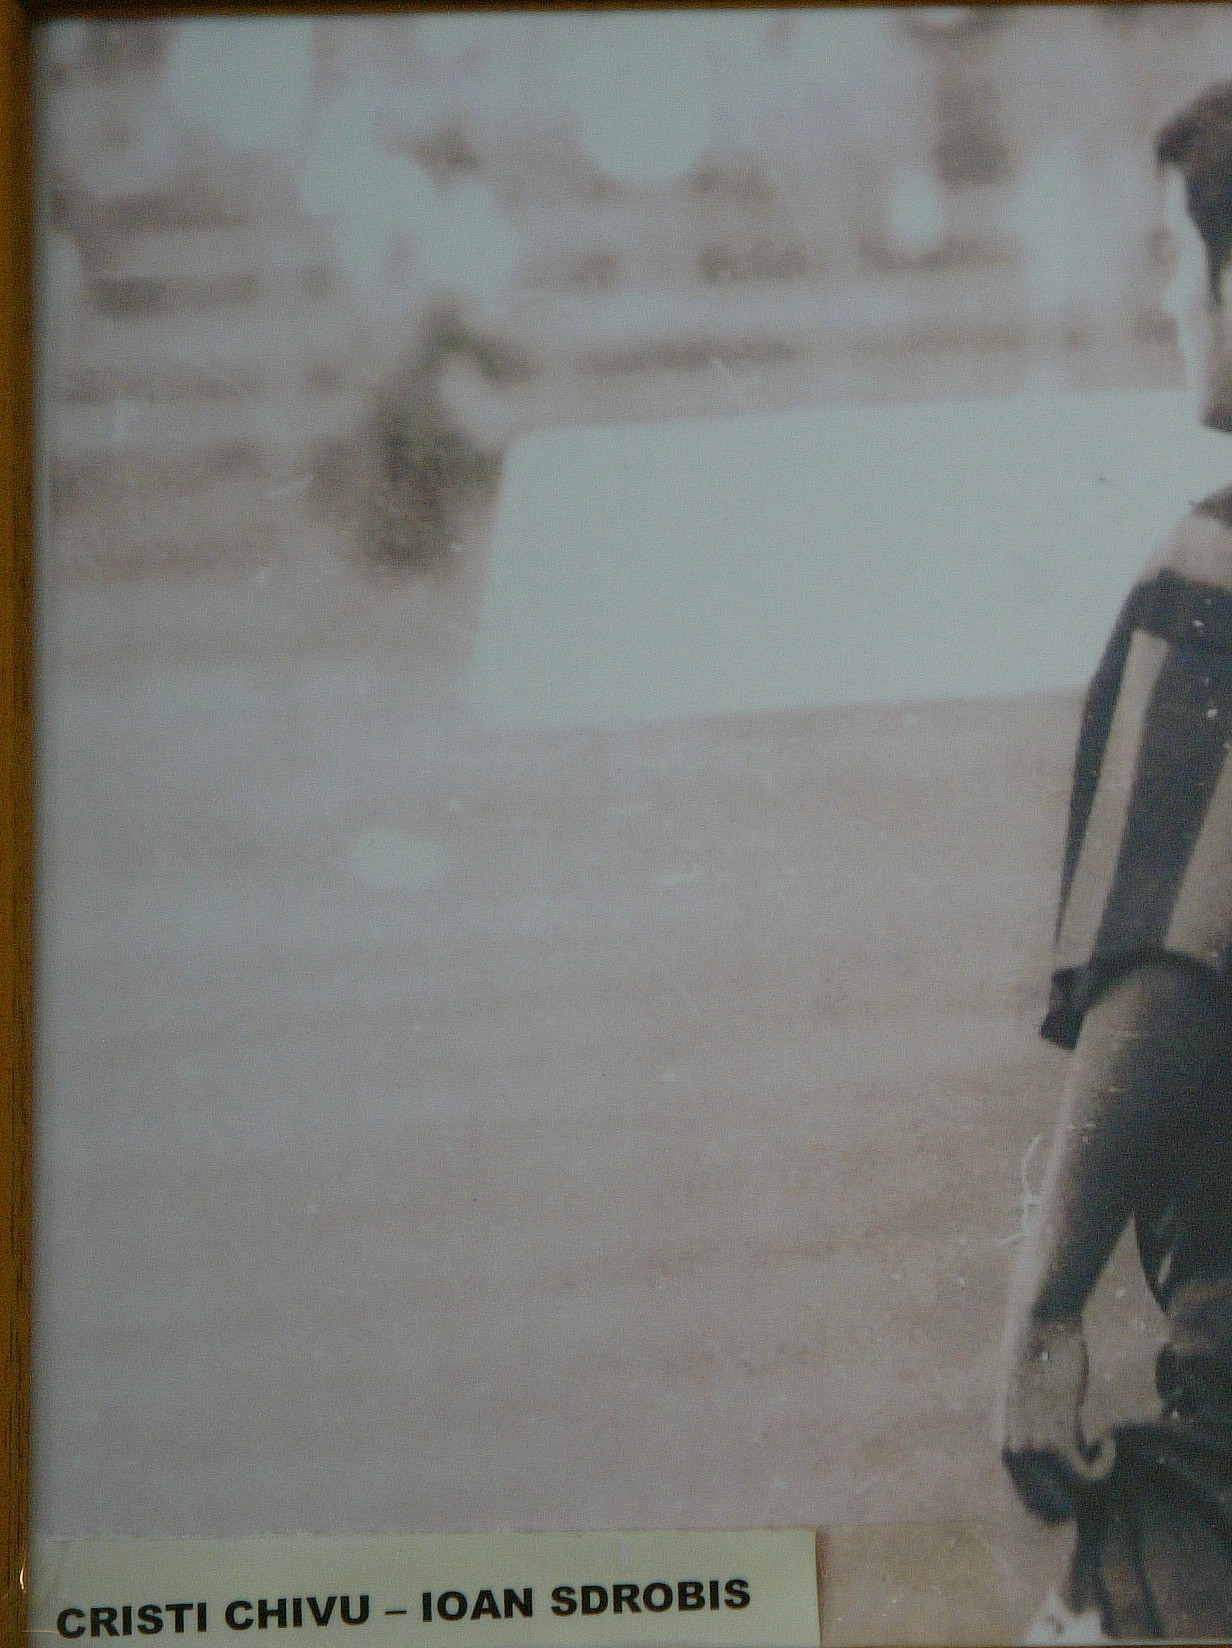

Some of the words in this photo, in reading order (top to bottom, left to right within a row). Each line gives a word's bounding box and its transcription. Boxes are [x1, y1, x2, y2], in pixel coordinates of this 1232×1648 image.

[56, 1602, 207, 1640] CRISTI
[224, 1594, 370, 1631] CHIVU
[421, 1587, 533, 1623] IOAN
[550, 1578, 751, 1617] SDROBIS
